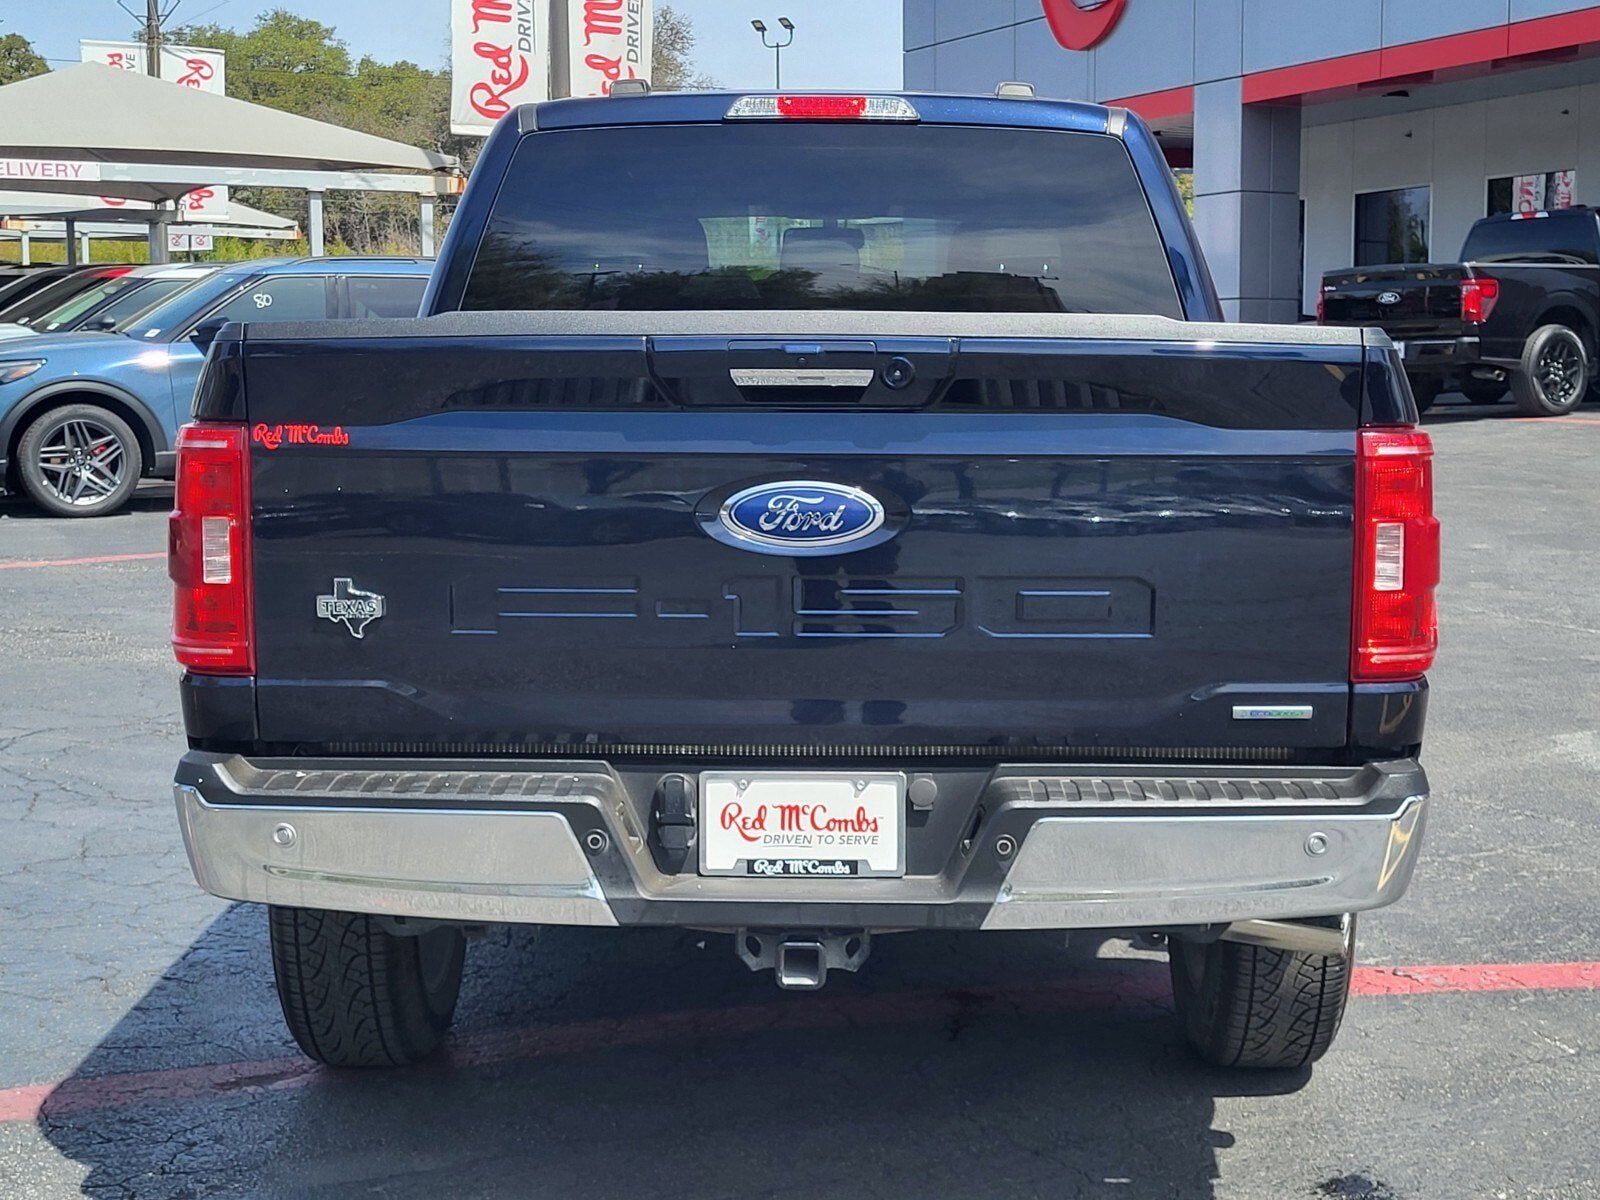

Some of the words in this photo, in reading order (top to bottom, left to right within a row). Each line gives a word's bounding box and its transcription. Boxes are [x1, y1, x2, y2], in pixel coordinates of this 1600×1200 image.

[517, 0, 532, 53] DRIV
[626, 0, 640, 64] DRIVE
[176, 58, 214, 89] Re
[470, 41, 529, 120] Red
[253, 291, 273, 309] 80
[253, 423, 283, 450] Red
[284, 425, 349, 445] McCombs
[759, 494, 847, 532] Ford
[321, 600, 377, 614] TEXAS
[720, 802, 768, 842] Red
[763, 834, 813, 846] DRIVEN
[816, 834, 835, 846] TO
[838, 834, 880, 846] SERVE
[753, 859, 784, 875] Red
[785, 859, 850, 875] McCombs
